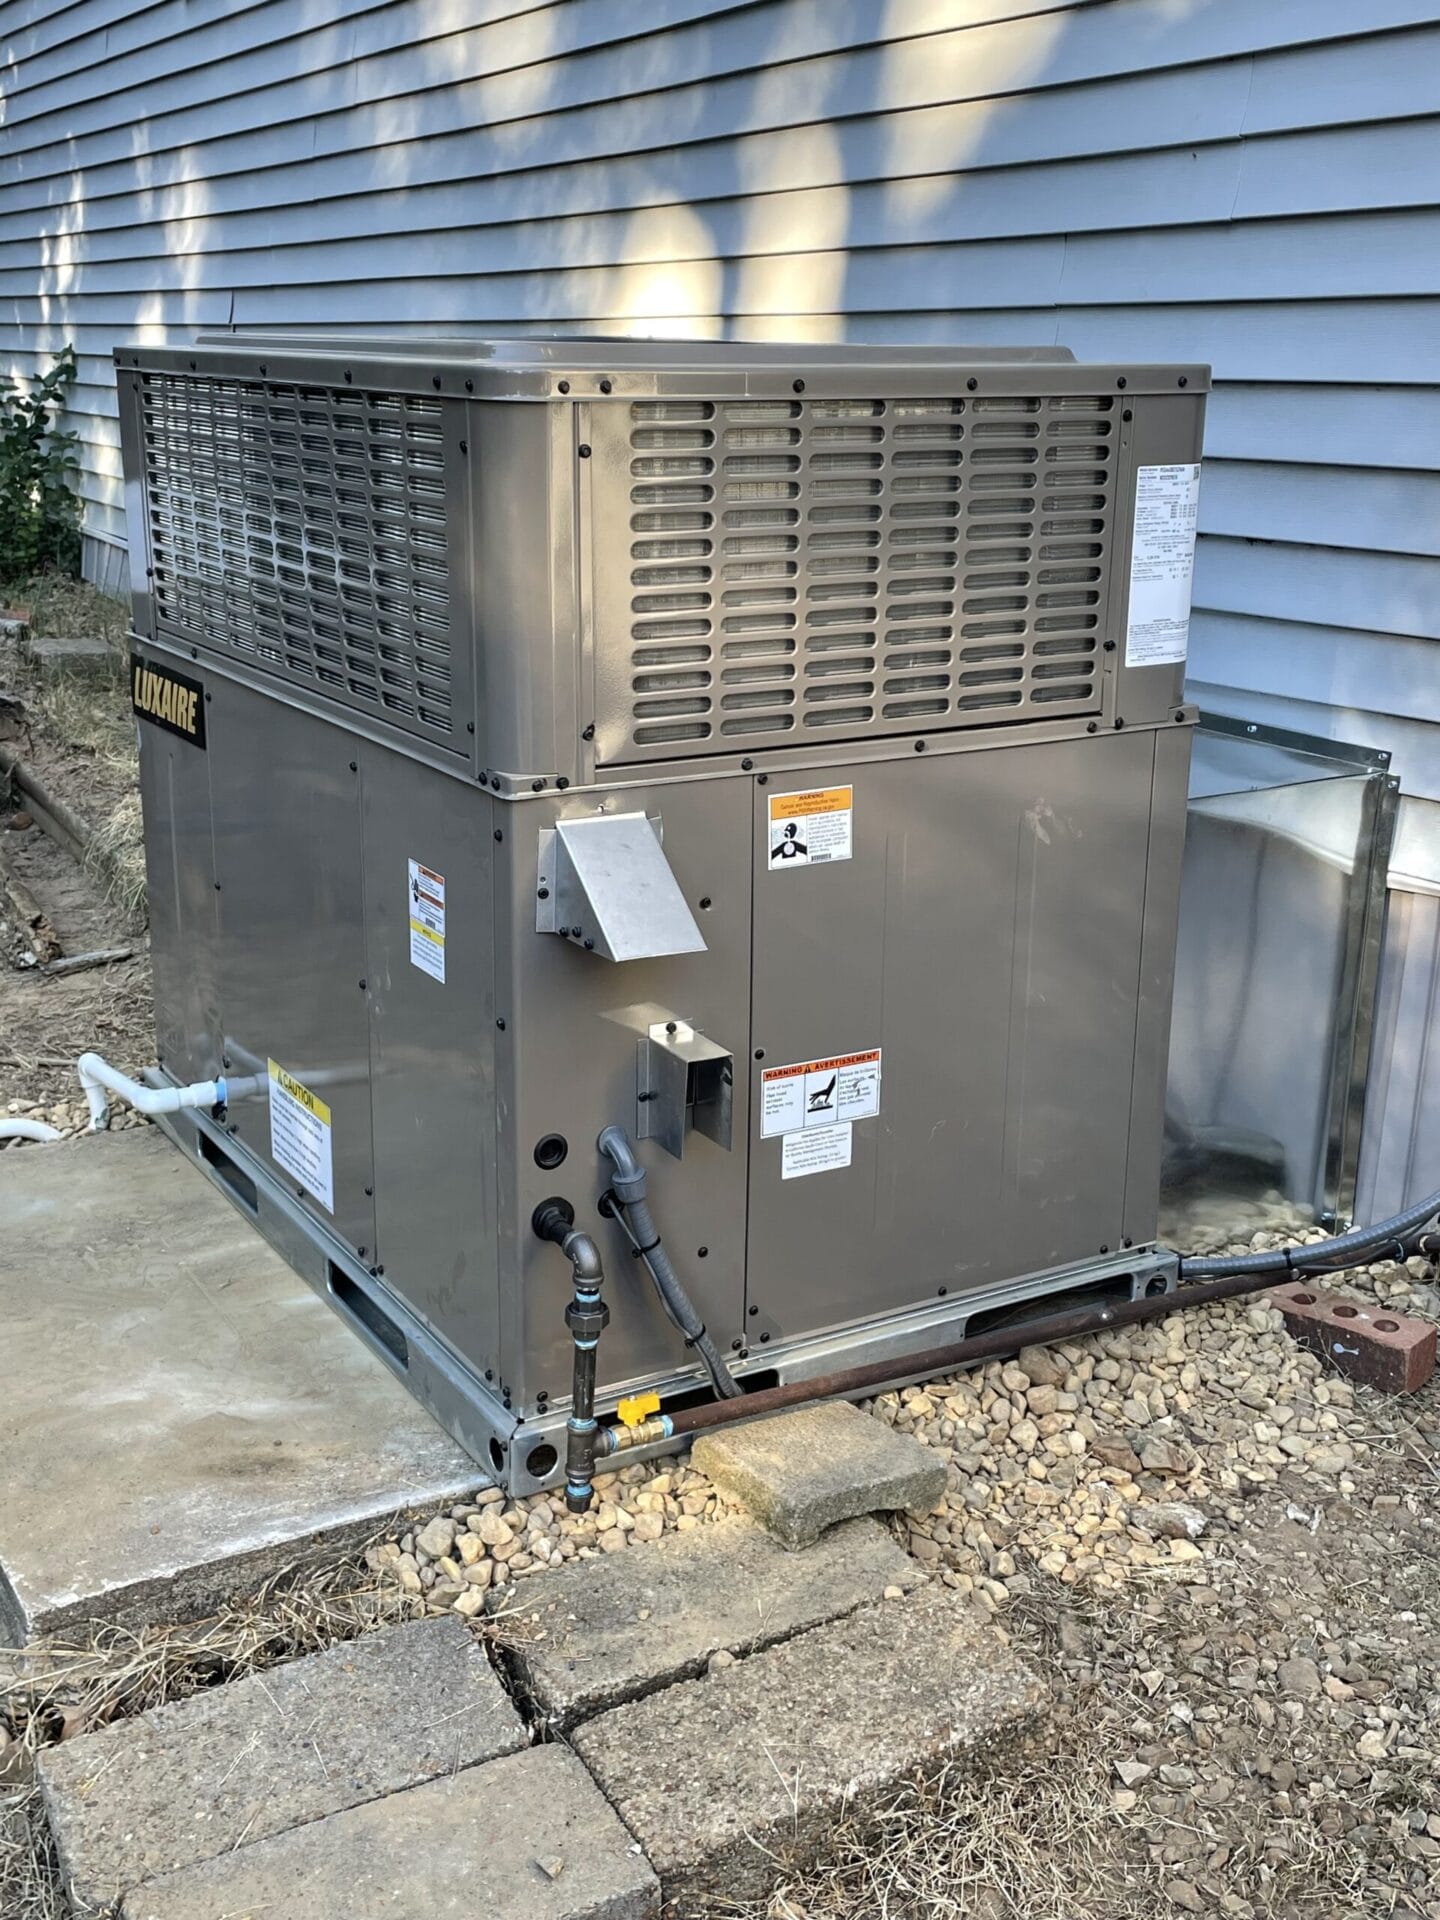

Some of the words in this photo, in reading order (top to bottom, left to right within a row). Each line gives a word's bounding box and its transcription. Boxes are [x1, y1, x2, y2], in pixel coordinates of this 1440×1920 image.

[134, 666, 198, 735] LUXAIRE
[765, 1066, 803, 1079] WARNING
[815, 1053, 877, 1069] AVERTISSEMENT
[282, 1073, 315, 1110] CAUTION
